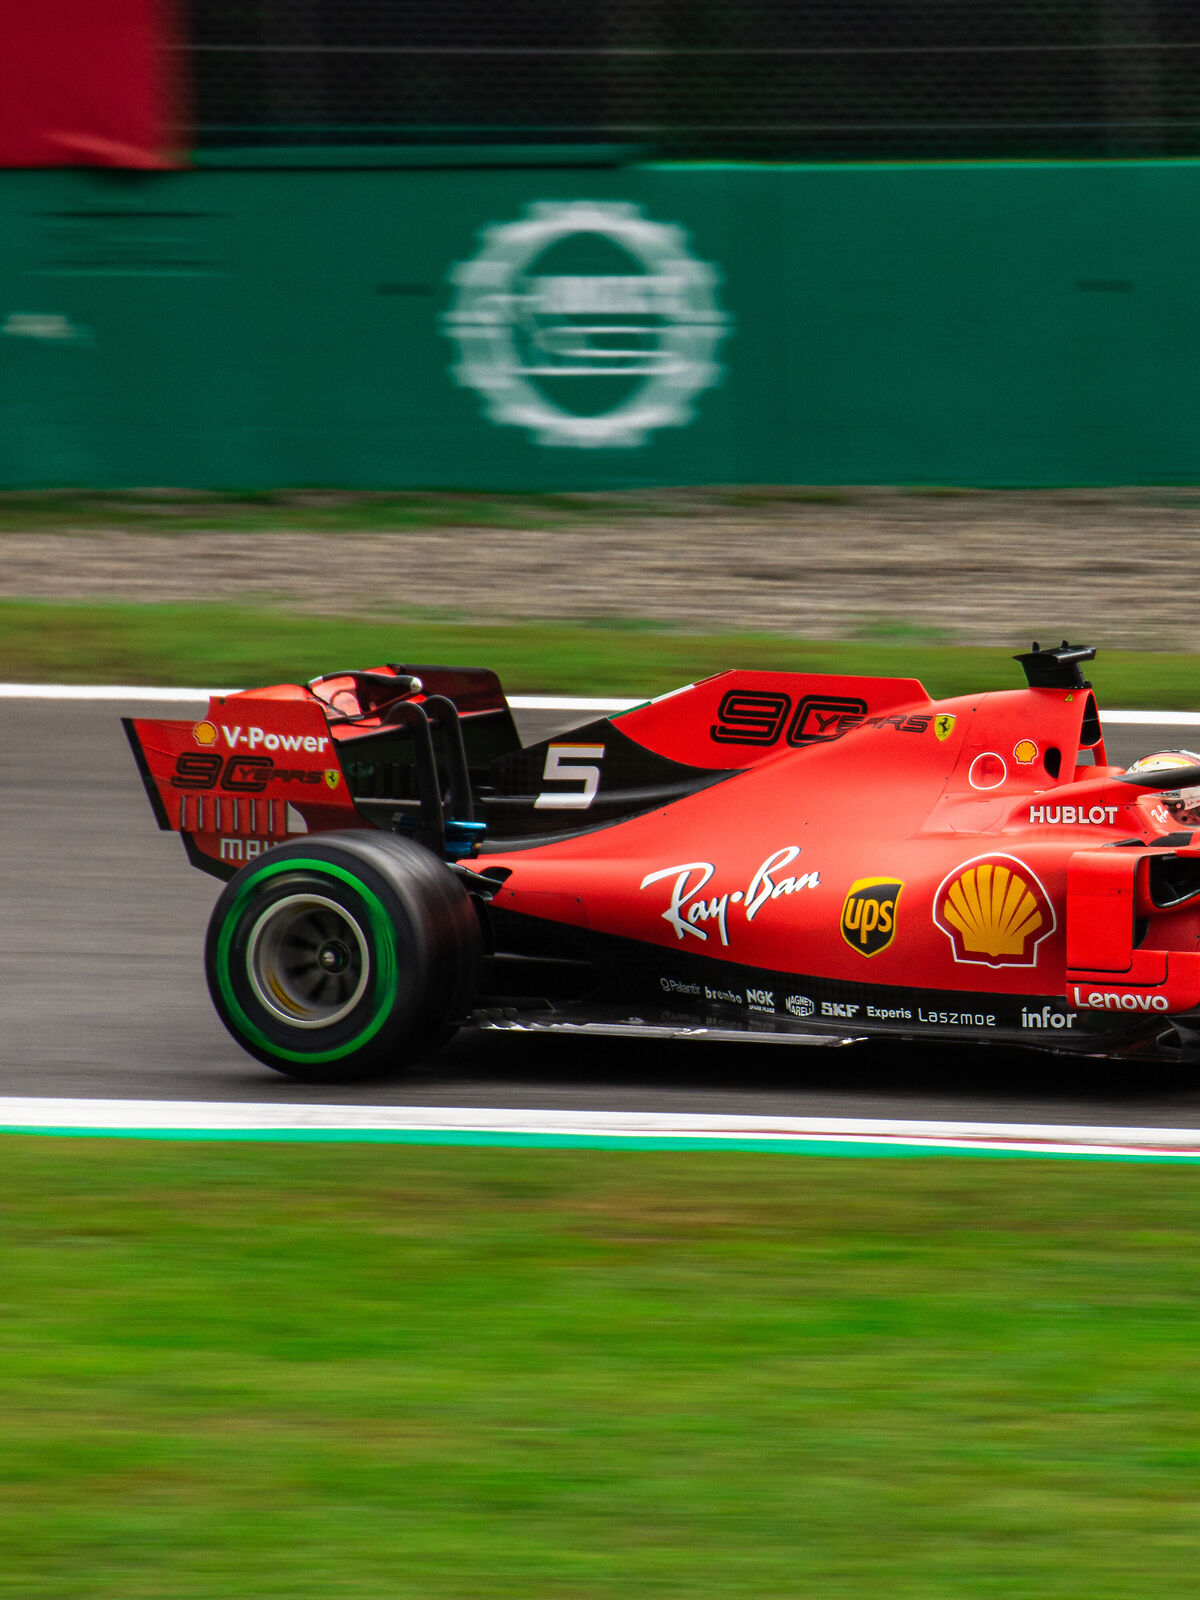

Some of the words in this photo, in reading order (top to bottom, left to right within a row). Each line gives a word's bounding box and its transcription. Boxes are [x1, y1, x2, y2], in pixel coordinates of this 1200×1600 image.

[221, 726, 329, 753] V-Power
[533, 742, 605, 809] 5
[1029, 805, 1118, 824] HUBLOT
[845, 898, 893, 944] ups
[704, 986, 743, 1004] brembo
[746, 989, 775, 1007] NGK
[1074, 987, 1169, 1011] Lenovo
[821, 1002, 859, 1017] SKF
[866, 1006, 912, 1019] Experis
[918, 1007, 996, 1026] Laszmoe
[1022, 1006, 1077, 1028] infor
